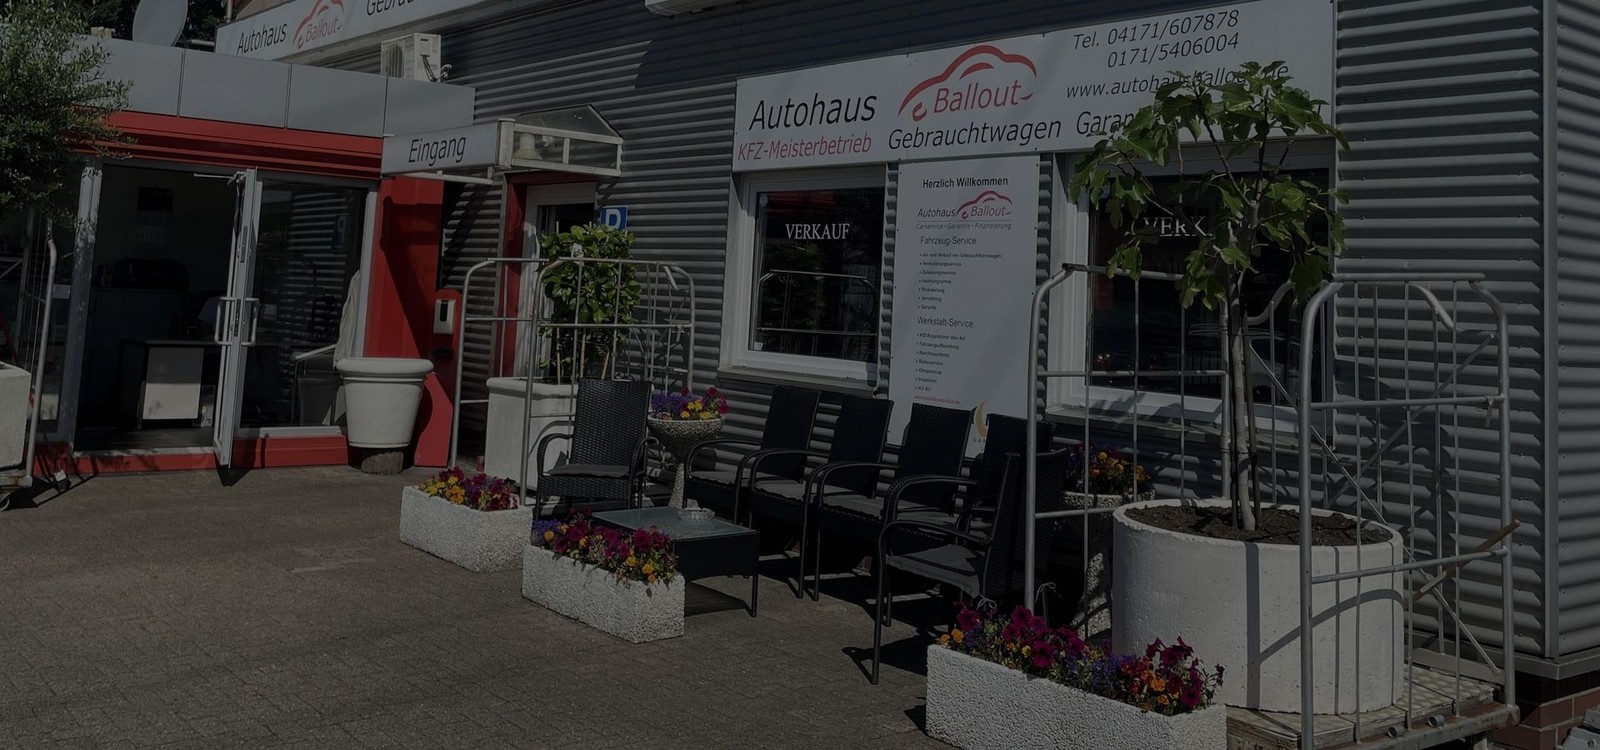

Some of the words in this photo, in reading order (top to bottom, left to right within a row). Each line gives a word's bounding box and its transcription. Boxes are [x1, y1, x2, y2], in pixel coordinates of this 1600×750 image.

[236, 23, 288, 55] Autohaus
[305, 18, 338, 42] Ballout
[1073, 33, 1100, 50] Tel.
[1107, 9, 1240, 46] 04171/607878
[1107, 32, 1240, 68] 0171/5406004
[749, 92, 877, 131] Autohaus
[933, 79, 1021, 114] Ballout
[737, 132, 872, 161] KFZ-Meisterbetrieb
[888, 119, 1062, 150] Gebrauchtwagen
[408, 135, 466, 166] Eingang
[922, 178, 955, 188] Herzlich
[957, 177, 1008, 187] Willkommen
[917, 208, 956, 218] Autohaus
[970, 205, 1006, 217] Ballout
[785, 223, 850, 240] VERKAUF
